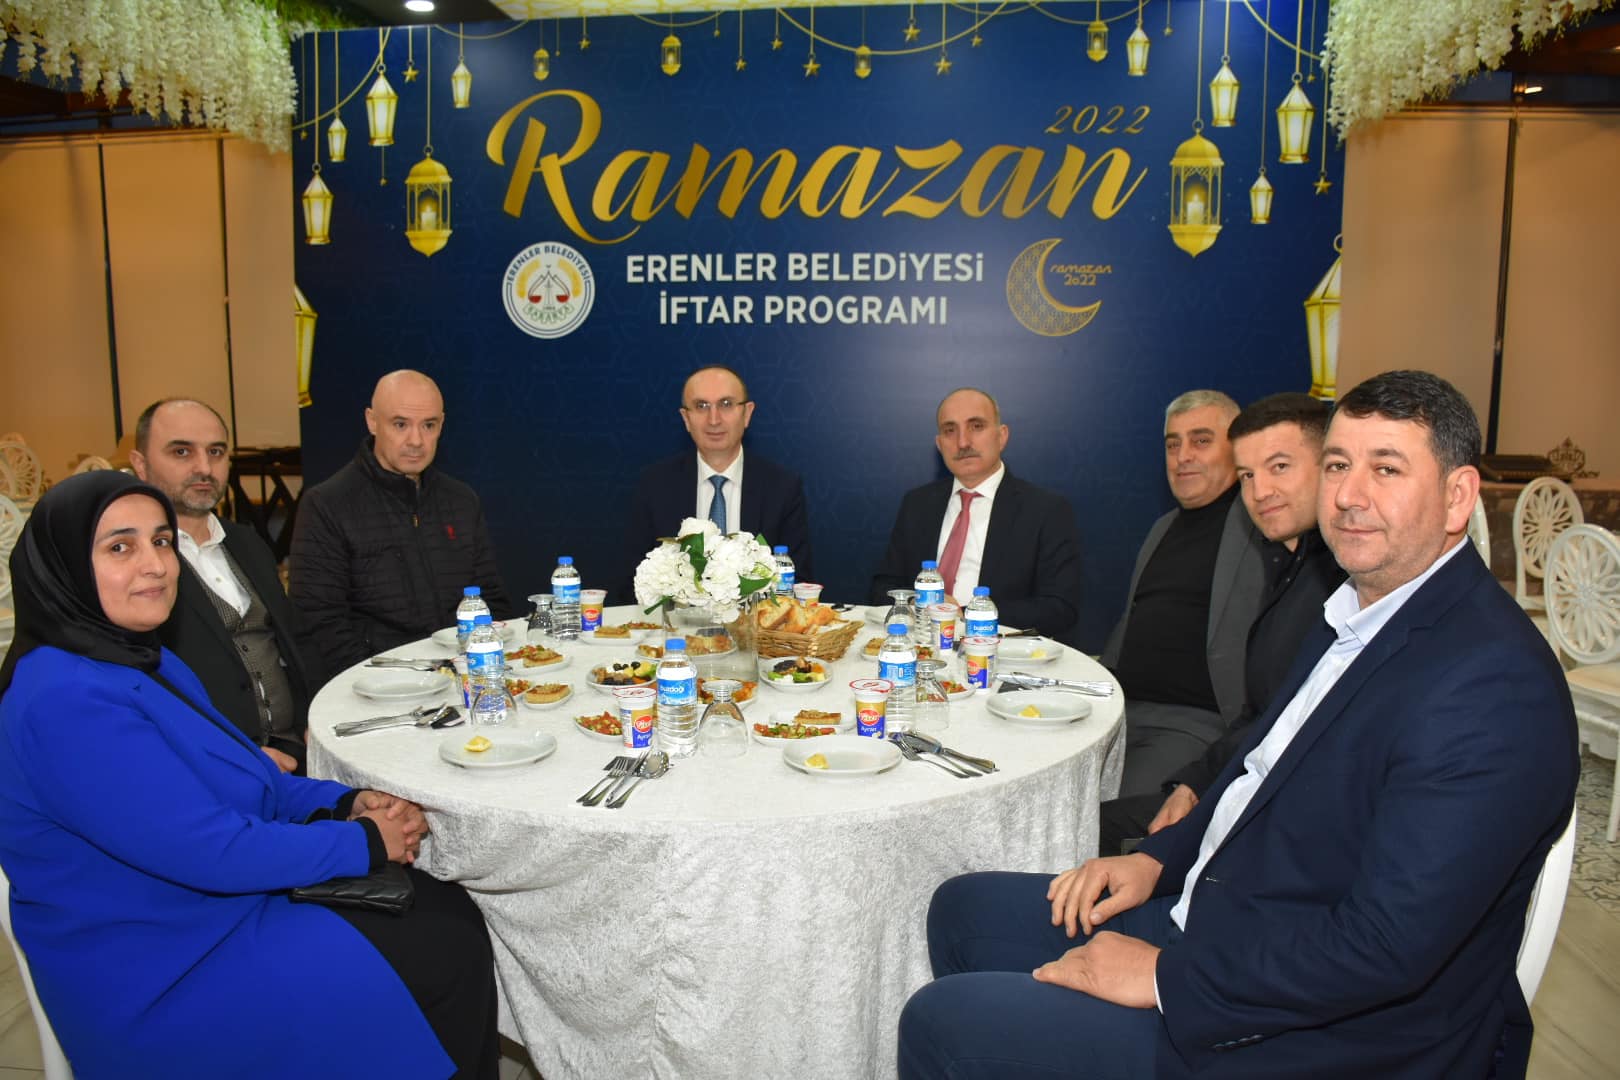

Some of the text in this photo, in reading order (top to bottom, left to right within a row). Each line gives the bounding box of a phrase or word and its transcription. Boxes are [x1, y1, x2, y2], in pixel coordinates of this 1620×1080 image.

[1044, 105, 1151, 134] 2022
[486, 90, 1148, 243] Ramazan
[507, 247, 541, 282] ERENLER
[626, 254, 777, 283] ERENLER
[659, 291, 948, 325] İFTAR PROGRAMI
